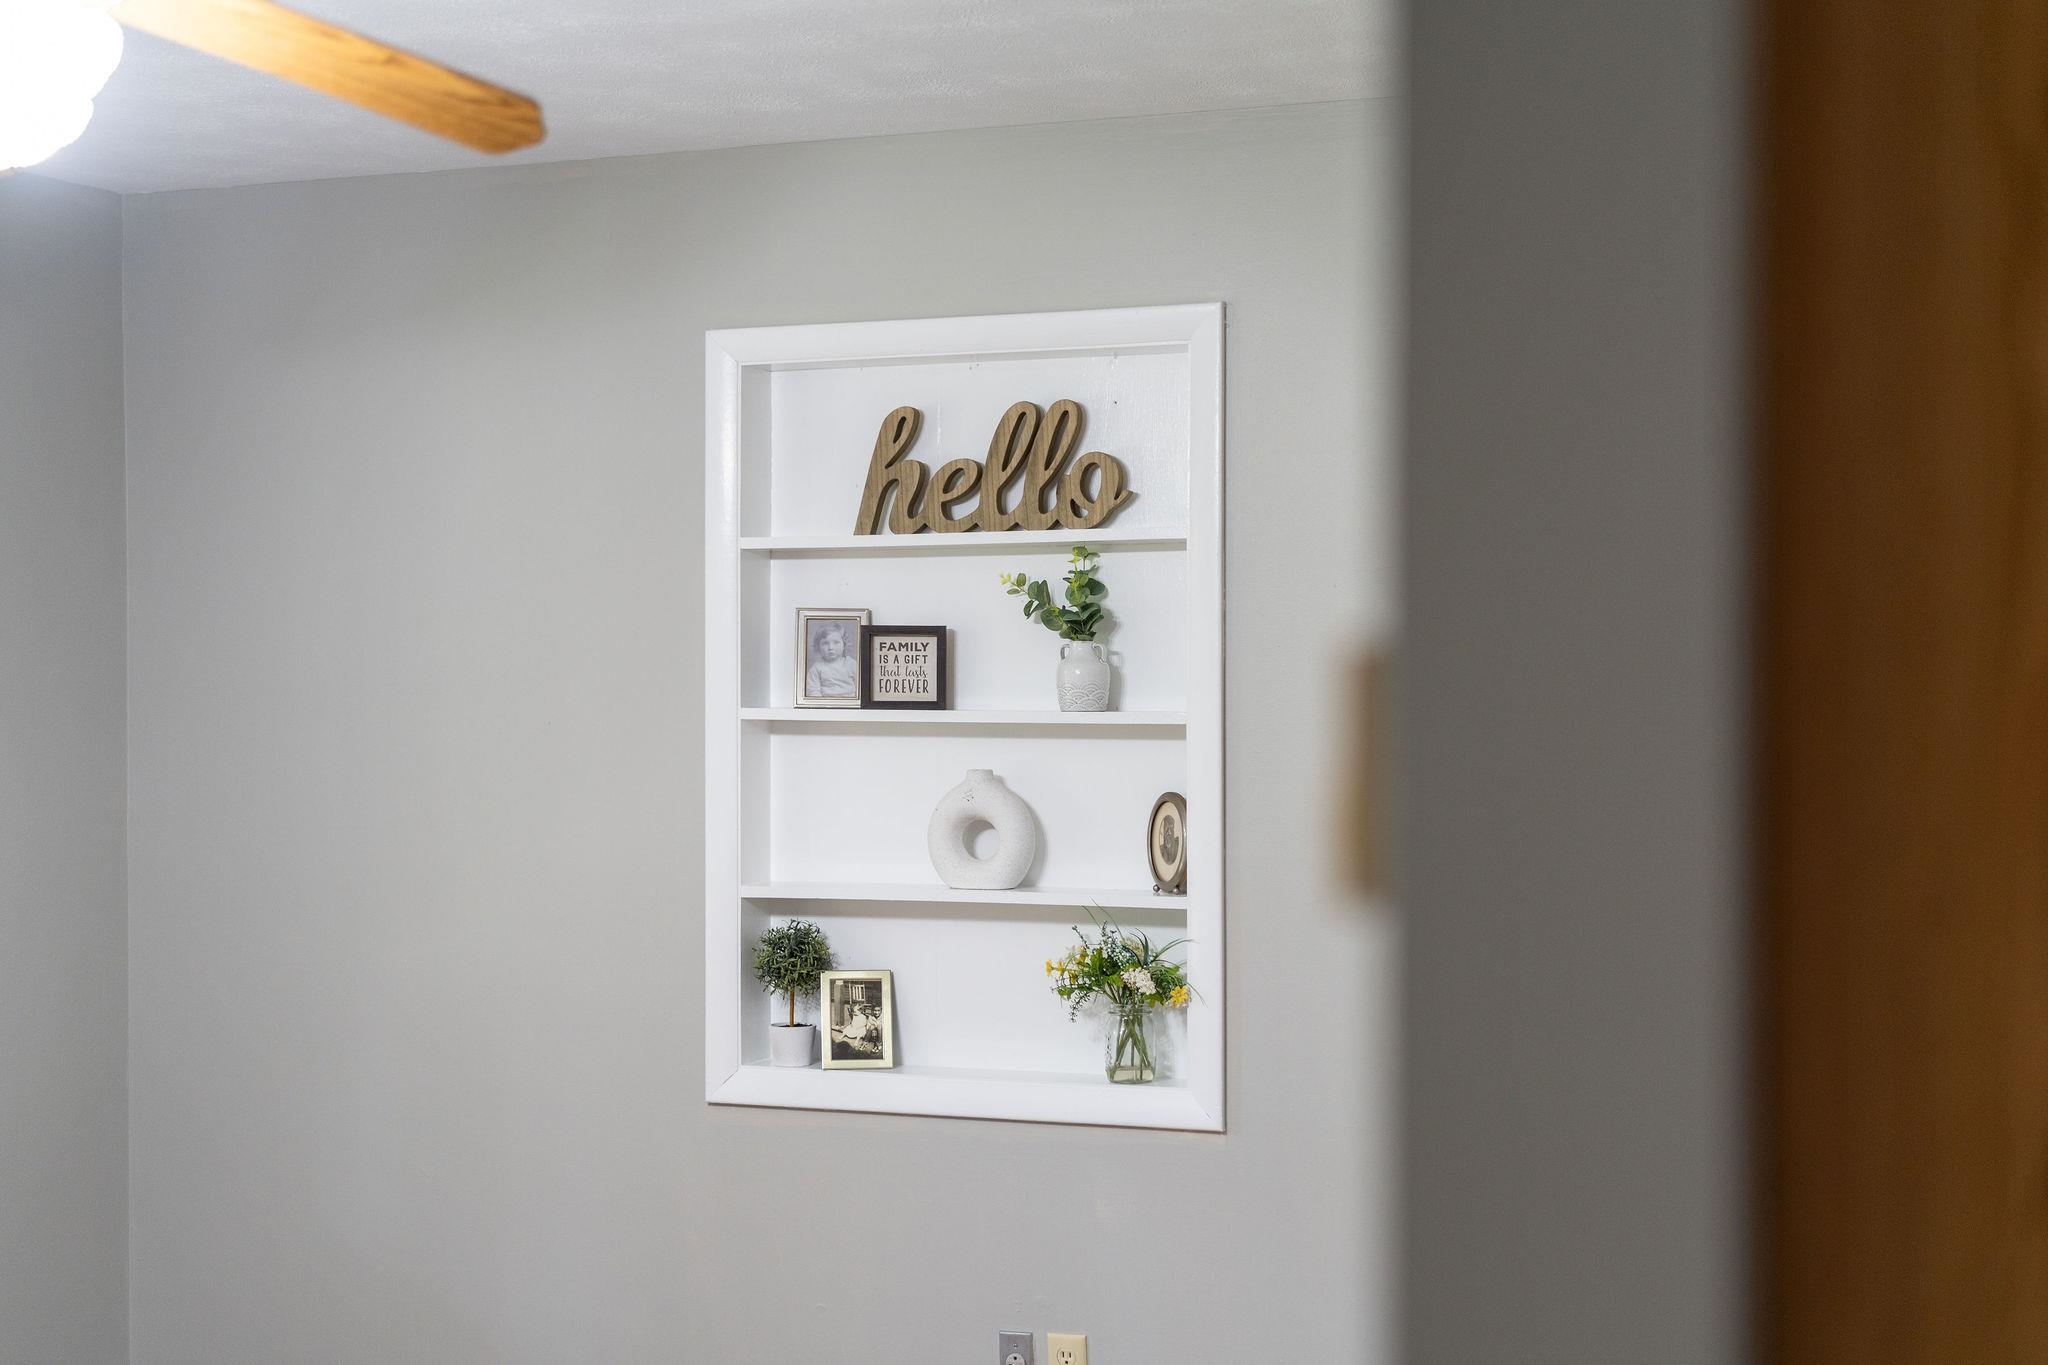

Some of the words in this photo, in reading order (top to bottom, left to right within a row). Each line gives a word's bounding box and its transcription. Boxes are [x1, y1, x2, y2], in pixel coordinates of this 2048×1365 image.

[853, 399, 1134, 536] hello
[879, 642, 930, 652] FAMILY
[879, 654, 889, 664] IS
[893, 654, 900, 664] A
[904, 654, 928, 664] GIFT
[880, 665, 901, 677] that
[905, 665, 928, 678] lasts
[879, 678, 929, 694] FOREVER
